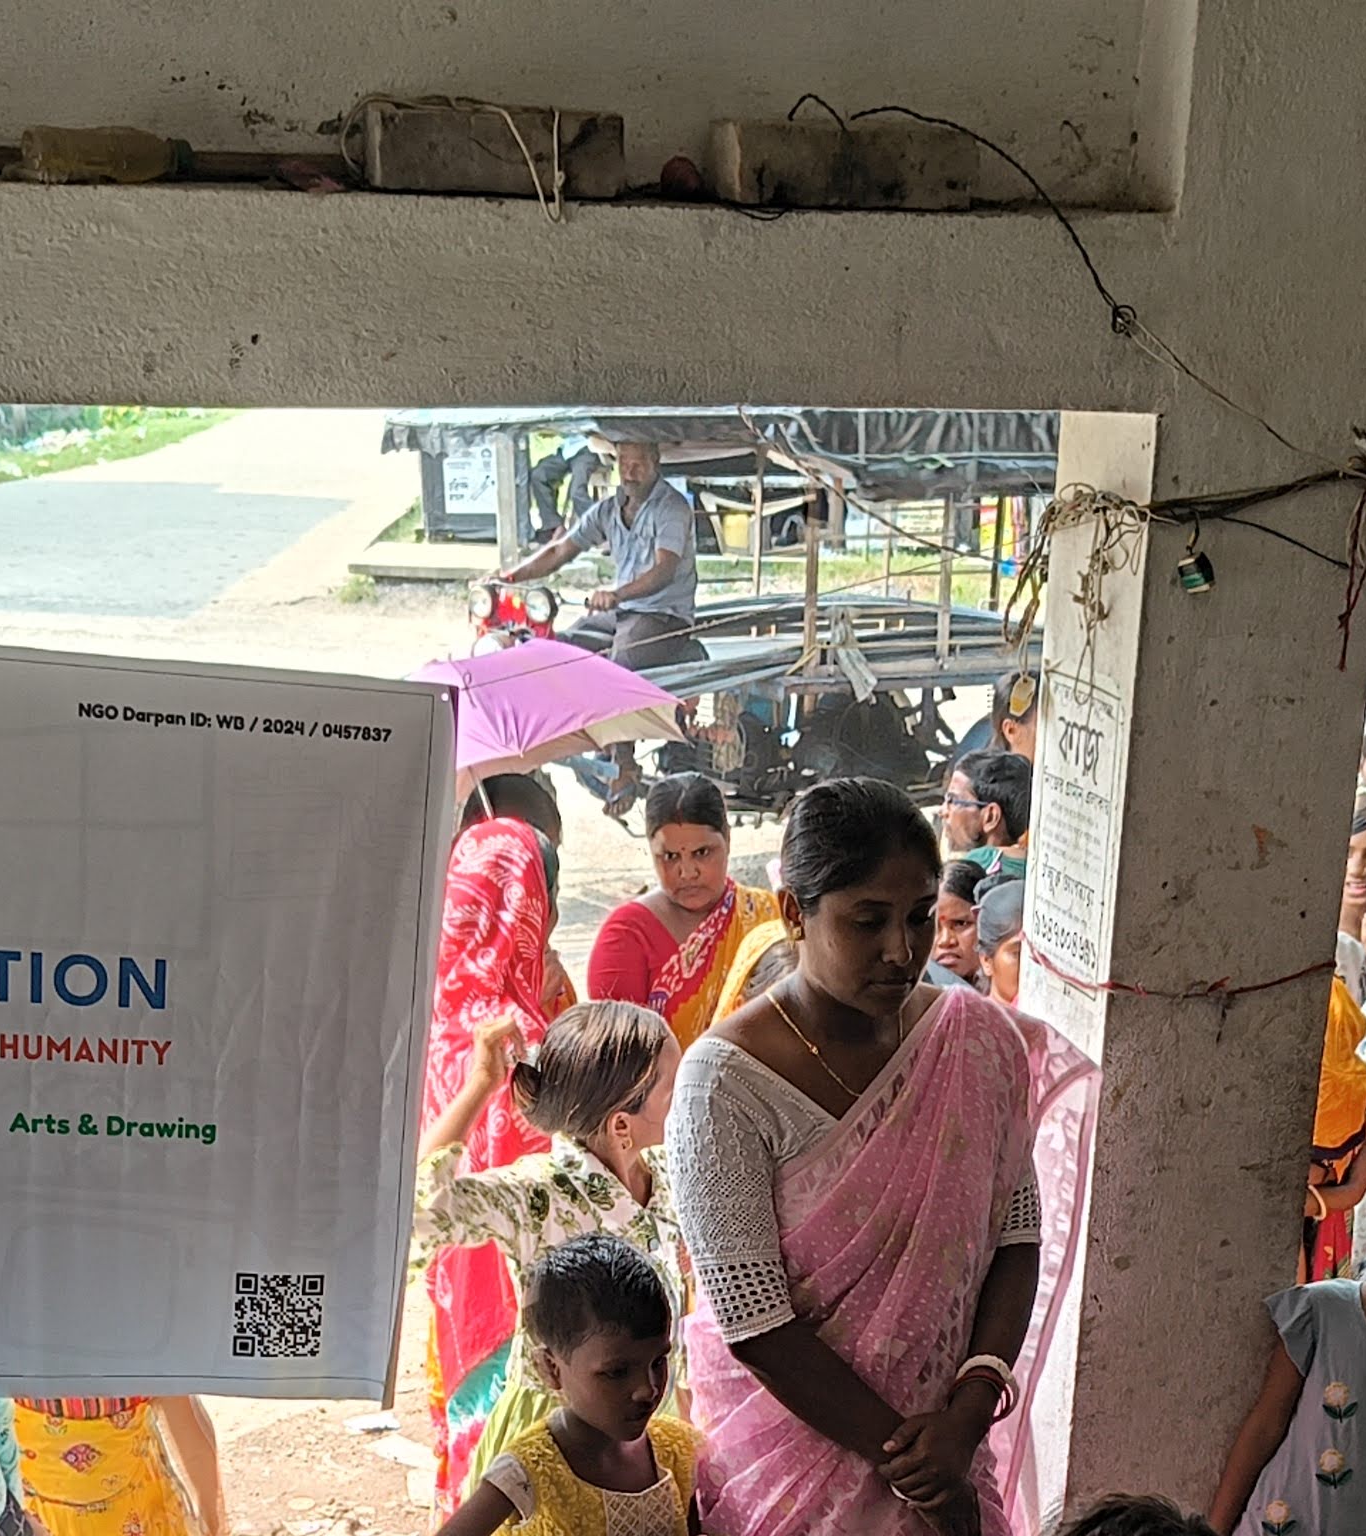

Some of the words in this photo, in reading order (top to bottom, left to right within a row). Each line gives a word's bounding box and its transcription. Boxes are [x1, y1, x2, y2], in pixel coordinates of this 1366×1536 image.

[78, 702, 119, 720] NGO
[122, 706, 187, 728] Darpan
[190, 711, 212, 729] ID:
[215, 714, 245, 731] WB
[248, 716, 259, 733] /
[262, 718, 305, 736] 2024
[308, 721, 319, 738] /
[322, 723, 393, 743] 0457837
[10, 1111, 69, 1134] Arts
[79, 1114, 98, 1137] &
[106, 1114, 217, 1143] Drawing
